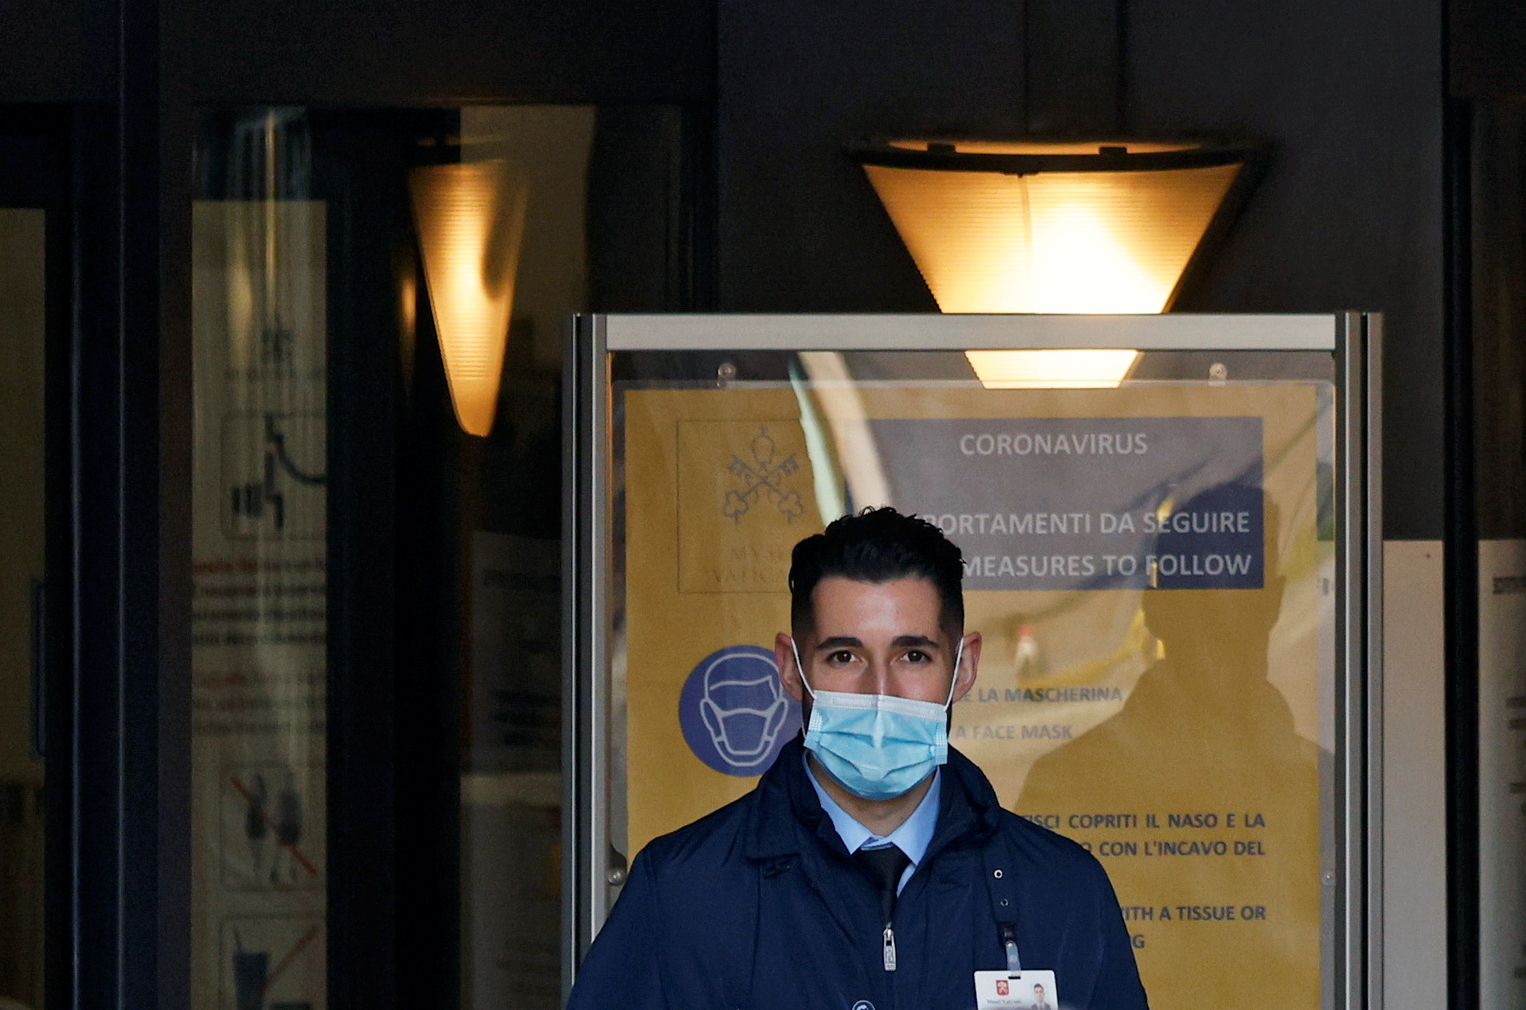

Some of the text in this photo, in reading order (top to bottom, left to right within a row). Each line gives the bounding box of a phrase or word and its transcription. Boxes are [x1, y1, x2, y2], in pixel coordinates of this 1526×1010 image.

[959, 433, 1148, 456] CORONAVIRUS
[1100, 513, 1136, 535] DA
[1143, 510, 1249, 534] SEGUIRE
[961, 553, 1252, 578] MEASURES TO FOLLOW
[978, 687, 999, 703] LA
[1005, 687, 1123, 703] MASCHERINA
[955, 725, 1074, 740] A FACE MASK
[1069, 814, 1138, 830] COPRITI
[1146, 814, 1160, 828] IL
[1168, 813, 1218, 828] NASO
[1227, 813, 1236, 828] E
[1244, 813, 1266, 828] LA
[1099, 841, 1138, 856] CON
[1144, 841, 1227, 856] L'INCAVO
[1234, 841, 1266, 856] DEL
[1121, 906, 1267, 921] ITH A TISSUE OR
